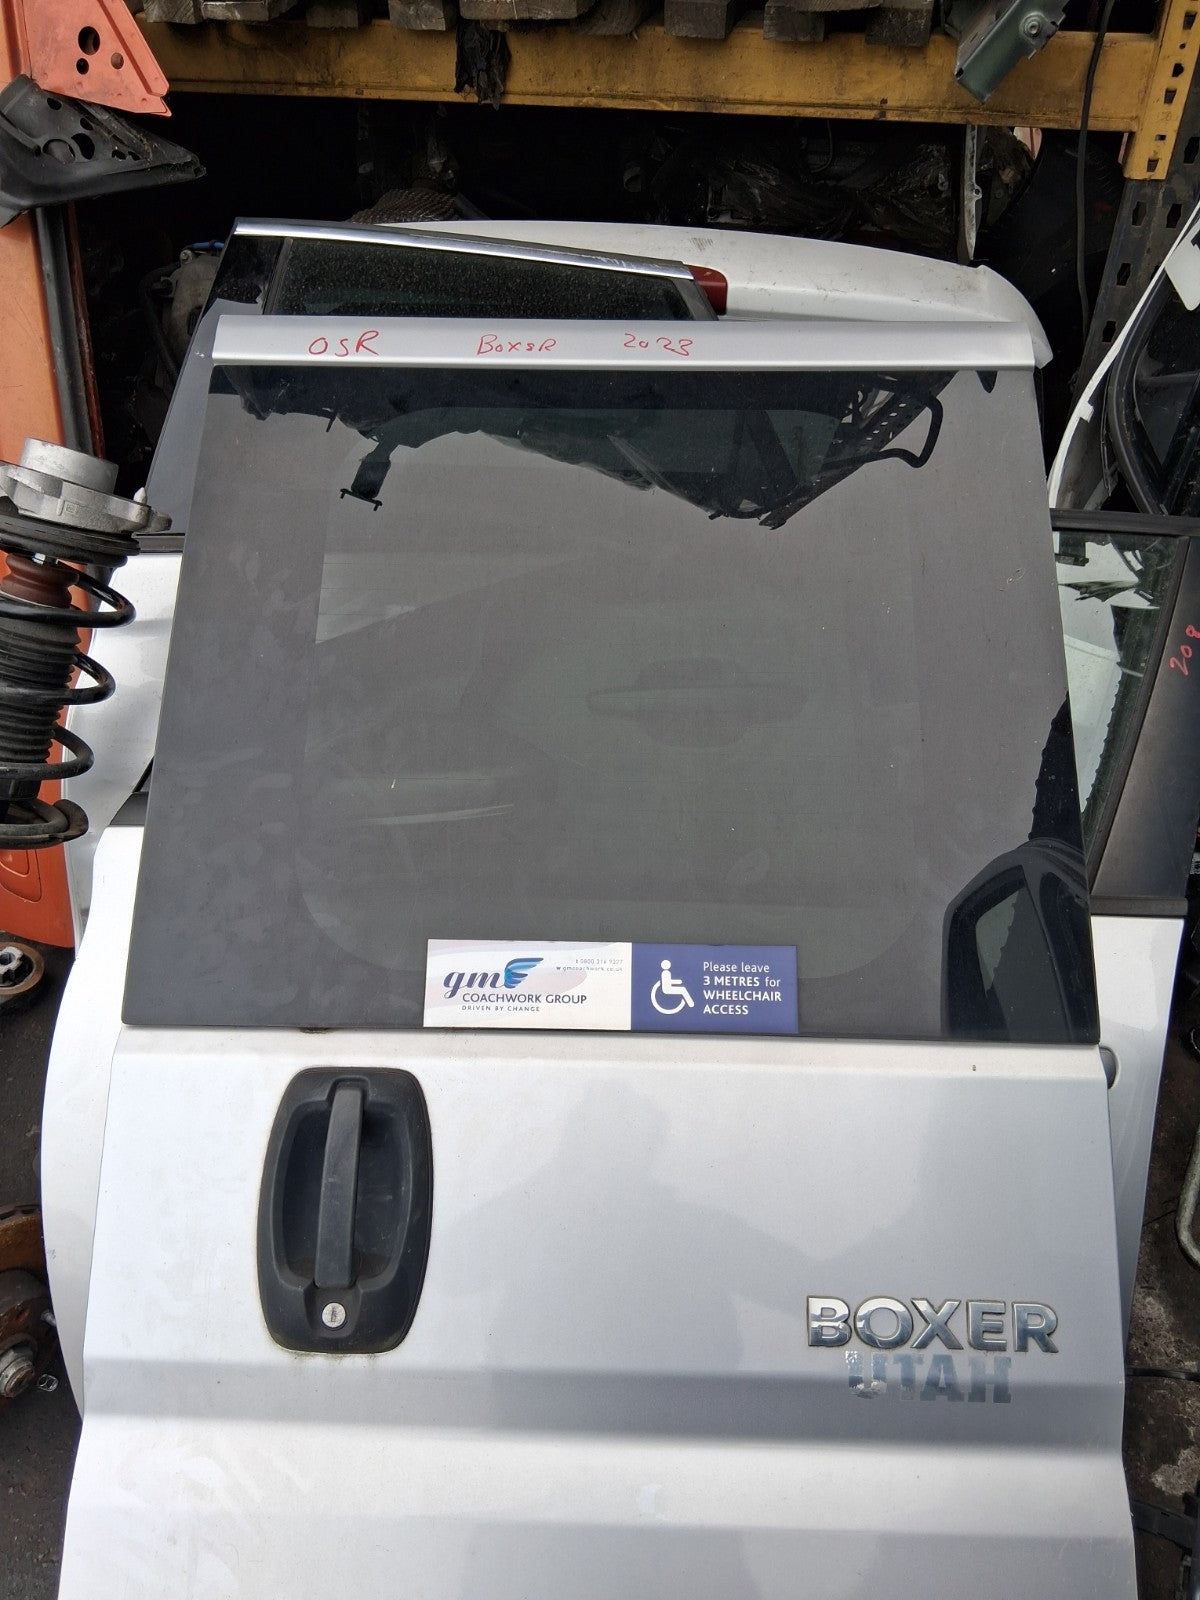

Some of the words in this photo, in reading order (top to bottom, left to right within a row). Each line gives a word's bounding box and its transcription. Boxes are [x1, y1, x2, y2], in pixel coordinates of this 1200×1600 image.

[308, 329, 380, 357] OSR
[623, 332, 694, 356] 2023
[703, 961, 738, 972] Please
[741, 962, 770, 973] leave
[443, 971, 505, 999] gm
[703, 975, 711, 986] 3
[714, 976, 760, 987] METRES
[765, 977, 781, 987] for
[462, 992, 542, 1004] COACHWORK
[545, 994, 587, 1004] GROUP
[703, 990, 782, 1001] WHEELCHAIR
[703, 1004, 749, 1015] ACCESS
[806, 1295, 1059, 1353] BOXER
[845, 1350, 1012, 1404] UTAH
